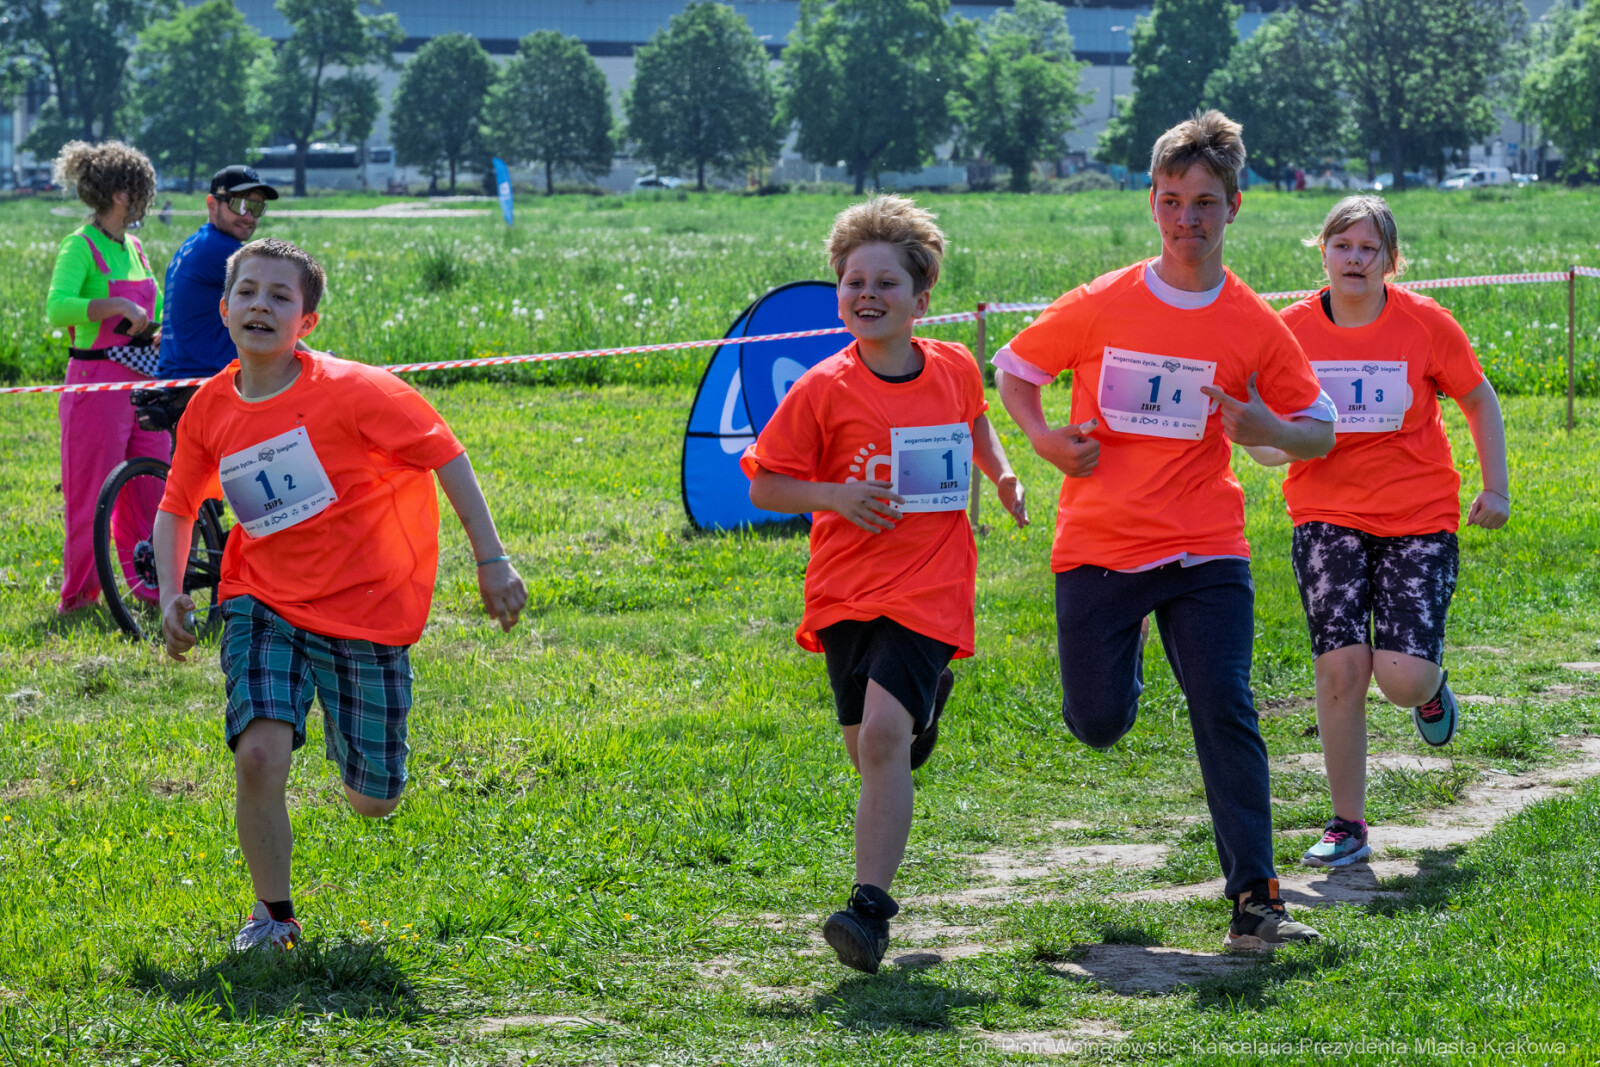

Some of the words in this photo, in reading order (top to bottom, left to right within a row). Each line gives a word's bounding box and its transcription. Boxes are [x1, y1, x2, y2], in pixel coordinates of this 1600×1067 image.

[1182, 364, 1205, 372] biegiem
[1148, 375, 1162, 403] 1
[1171, 389, 1182, 404] 4
[1351, 378, 1363, 404] 1
[1375, 389, 1384, 402] 3
[276, 441, 299, 453] biegiem
[942, 449, 954, 480] 1
[963, 460, 968, 476] 1
[255, 470, 275, 500] 1
[283, 474, 297, 490] 2
